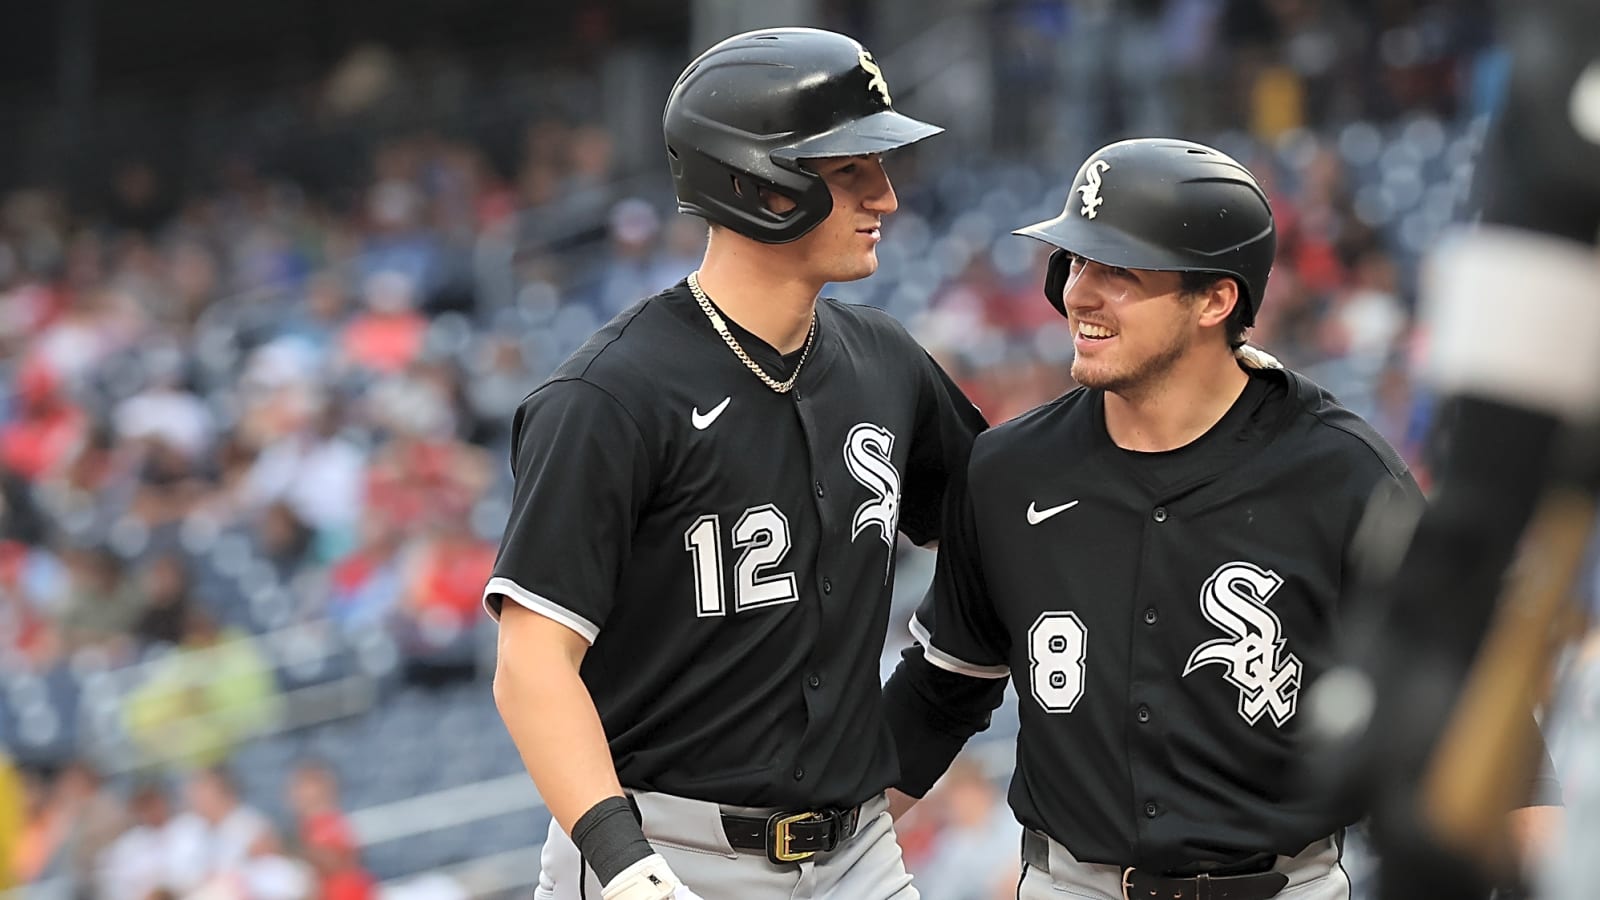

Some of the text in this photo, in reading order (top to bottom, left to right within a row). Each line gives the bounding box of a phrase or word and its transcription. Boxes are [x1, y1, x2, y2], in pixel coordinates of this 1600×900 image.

[1076, 159, 1111, 220] Sox
[843, 422, 901, 548] So
[684, 503, 800, 618] 12
[1027, 610, 1088, 714] 8
[1182, 561, 1303, 728] Sox
